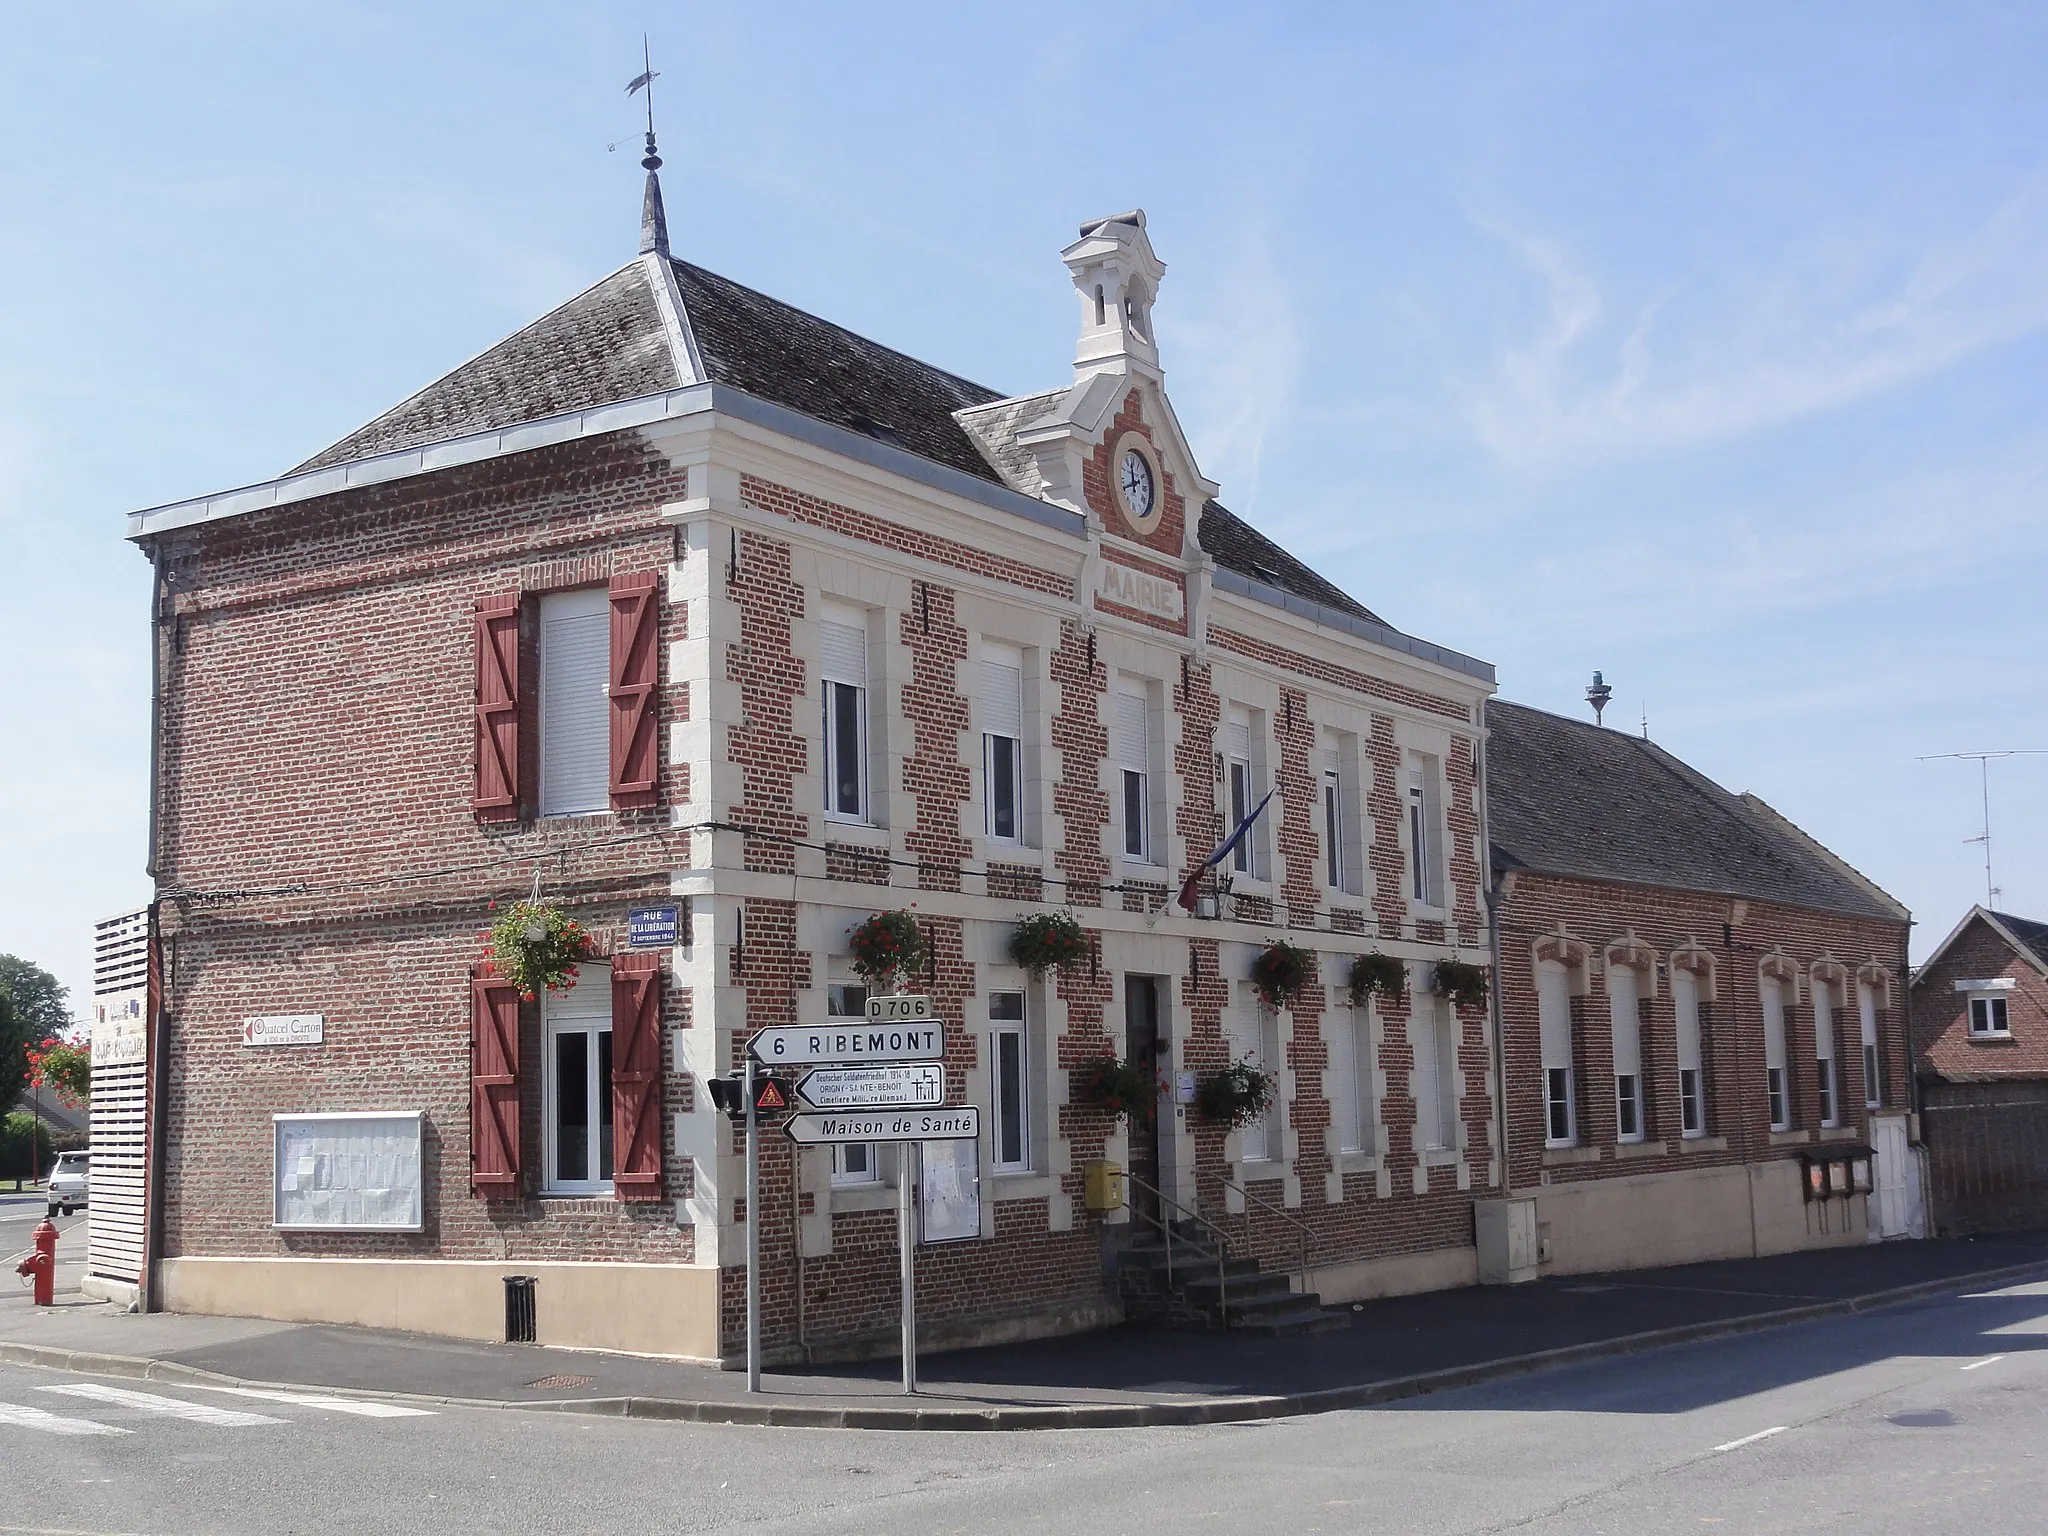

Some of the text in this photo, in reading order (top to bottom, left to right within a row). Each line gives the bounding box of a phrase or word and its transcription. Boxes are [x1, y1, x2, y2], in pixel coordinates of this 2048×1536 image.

[643, 911, 663, 920] RUE
[631, 924, 637, 933] DE
[638, 924, 644, 932] LA
[871, 1001, 925, 1016] D 706
[773, 1031, 934, 1055] 6 RIBEMONT
[816, 1072, 843, 1082] Deutscher
[843, 1070, 887, 1082] Soldatenfriedhof
[822, 1115, 972, 1135] Maison de Santé
